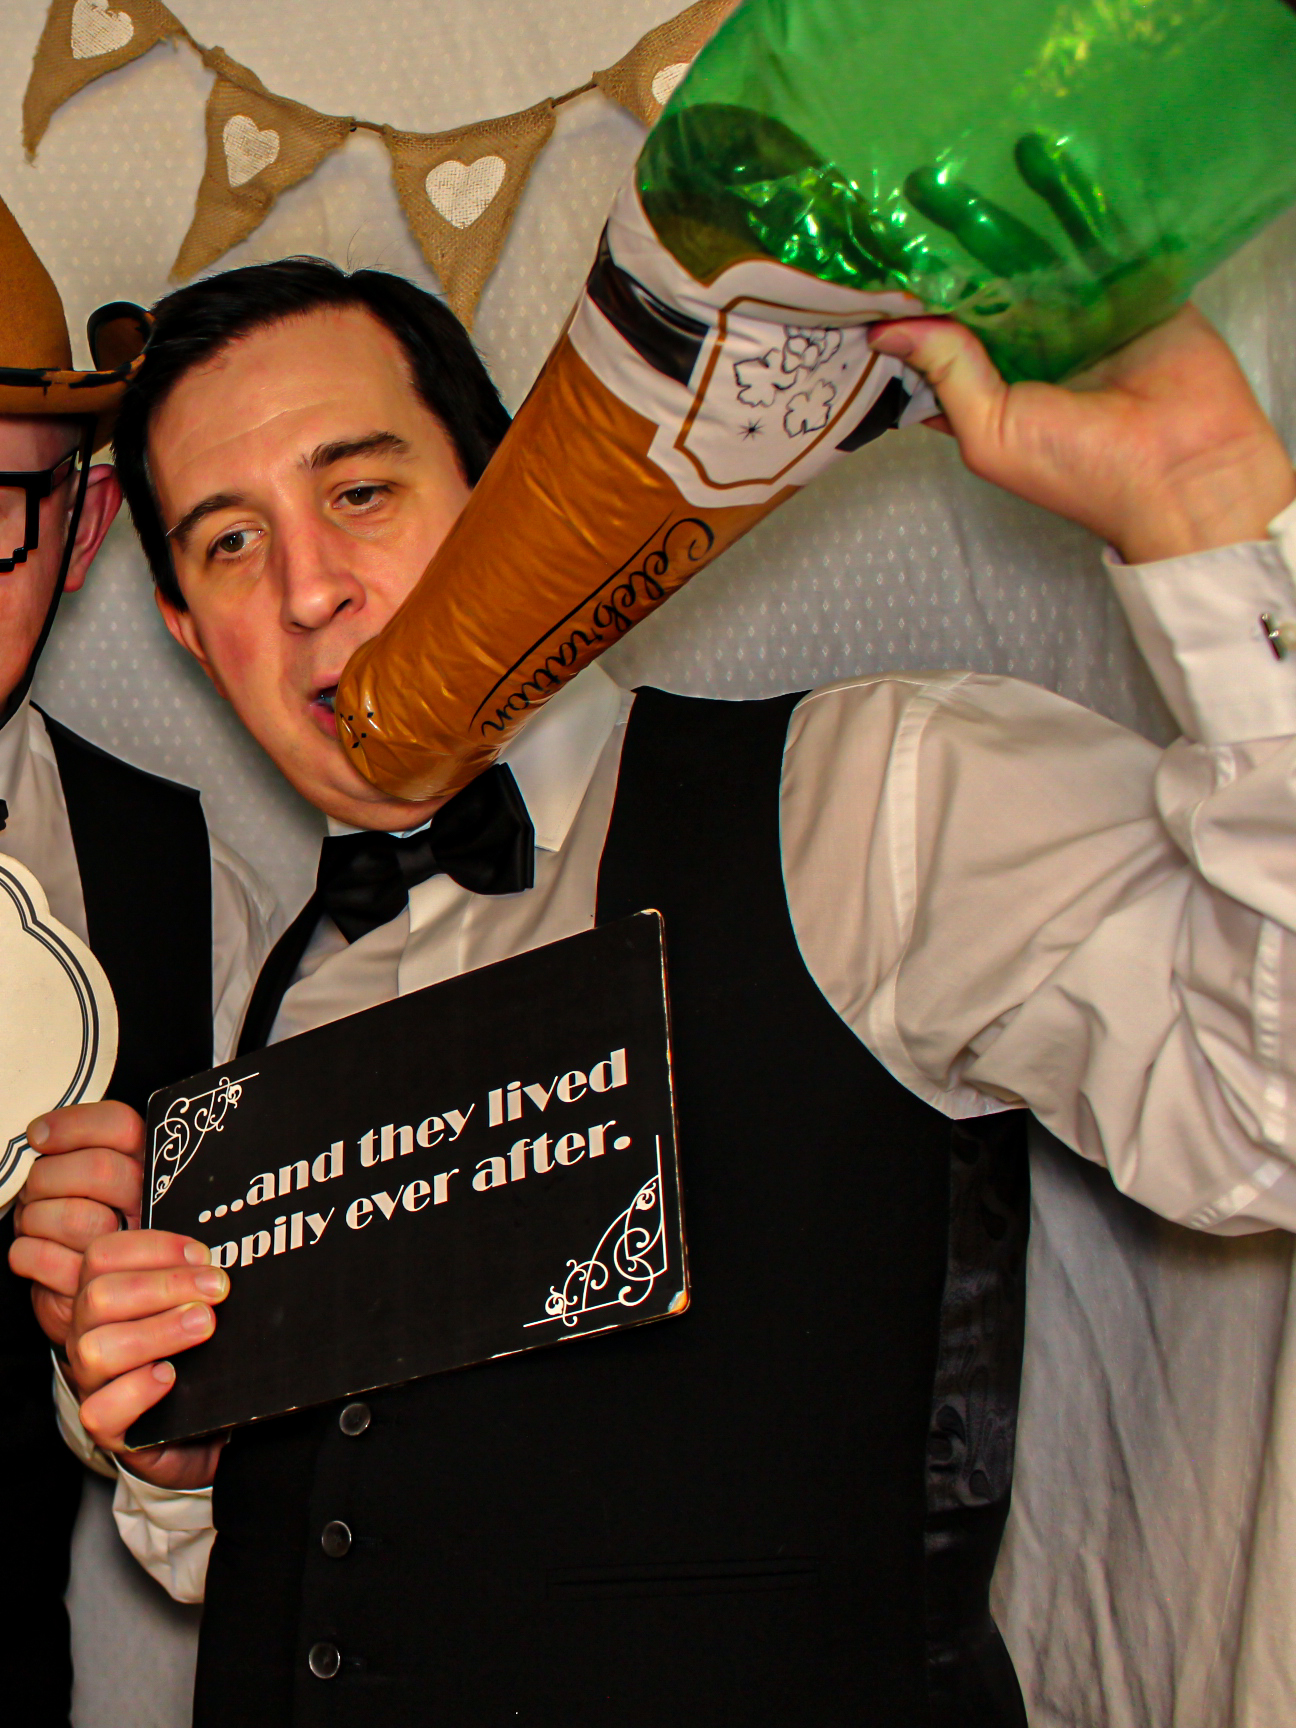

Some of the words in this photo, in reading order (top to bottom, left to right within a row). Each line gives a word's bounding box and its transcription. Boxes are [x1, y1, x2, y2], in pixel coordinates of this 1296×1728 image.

[481, 517, 715, 737] Celebration
[357, 1103, 475, 1168] they
[488, 1047, 628, 1128] lived
[209, 1206, 335, 1269] ppily
[345, 1168, 460, 1230] ever
[472, 1120, 631, 1192] after.
